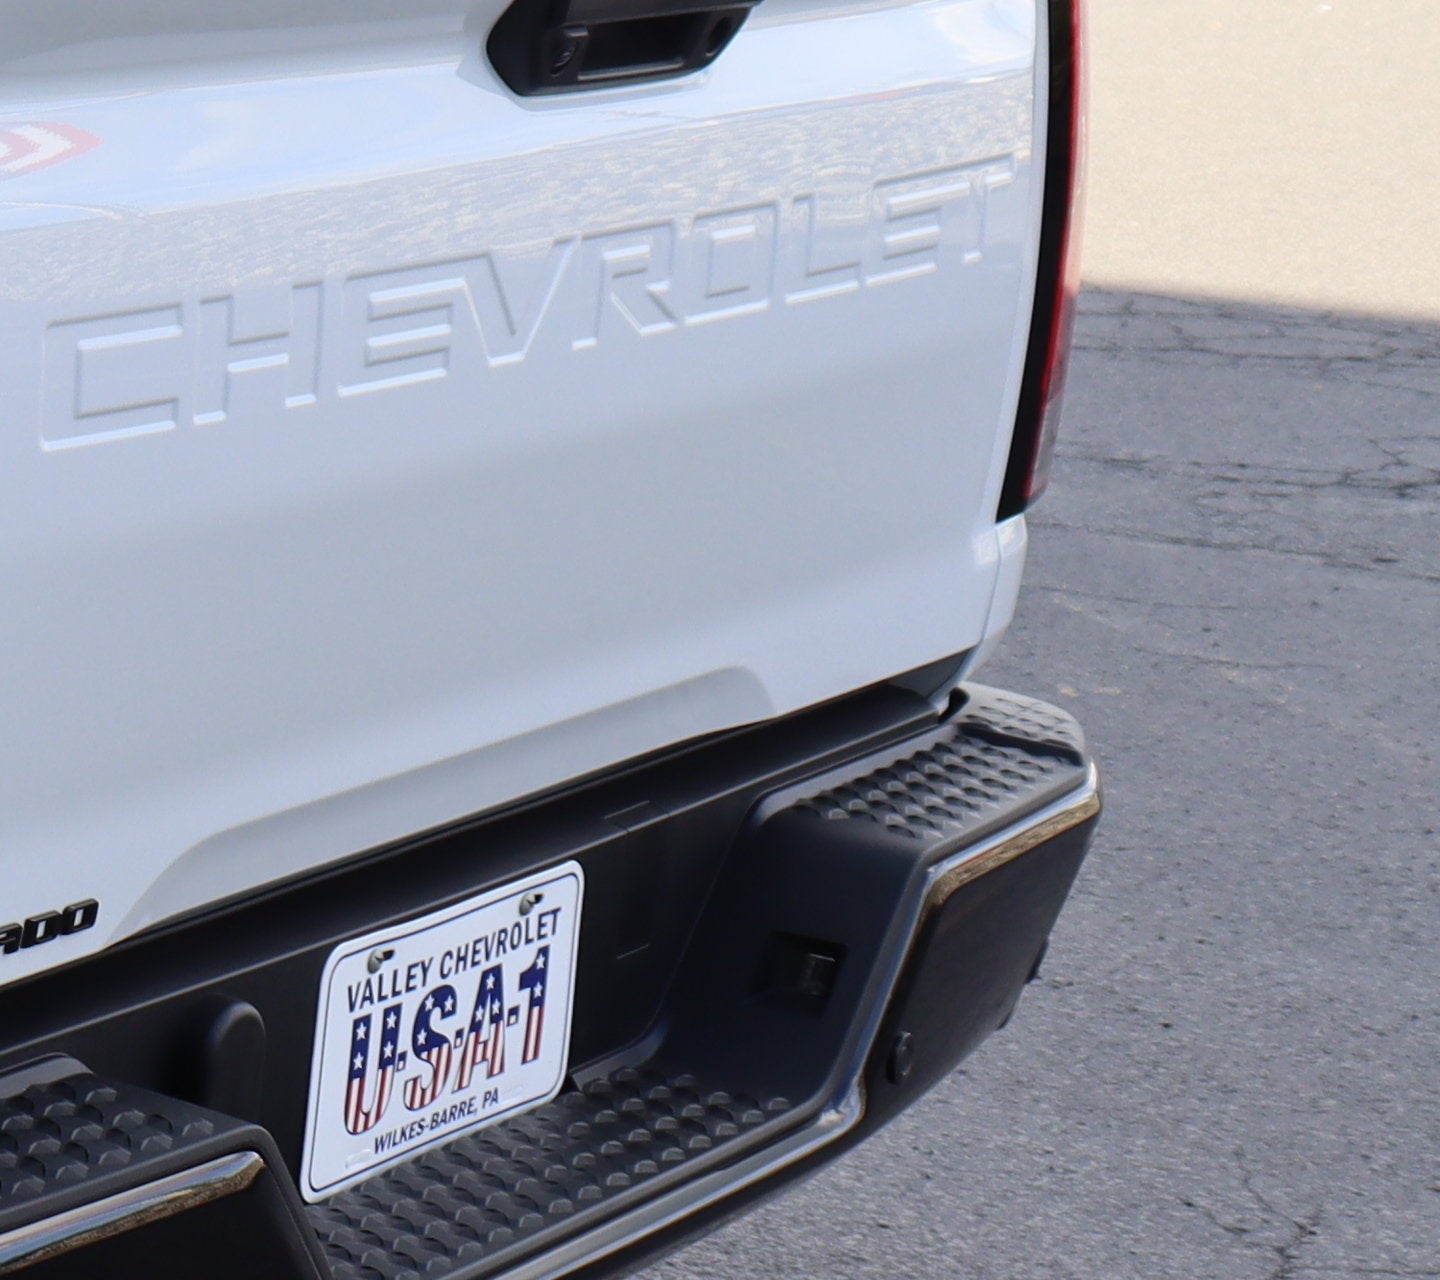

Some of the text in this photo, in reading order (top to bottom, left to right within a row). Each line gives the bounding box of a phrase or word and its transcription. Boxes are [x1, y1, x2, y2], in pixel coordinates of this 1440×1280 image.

[39, 153, 1017, 453] CHEVROLET
[347, 907, 562, 1013] VALLEY CHEVROLET
[373, 1087, 499, 1154] WILKES-BARRE, PA
